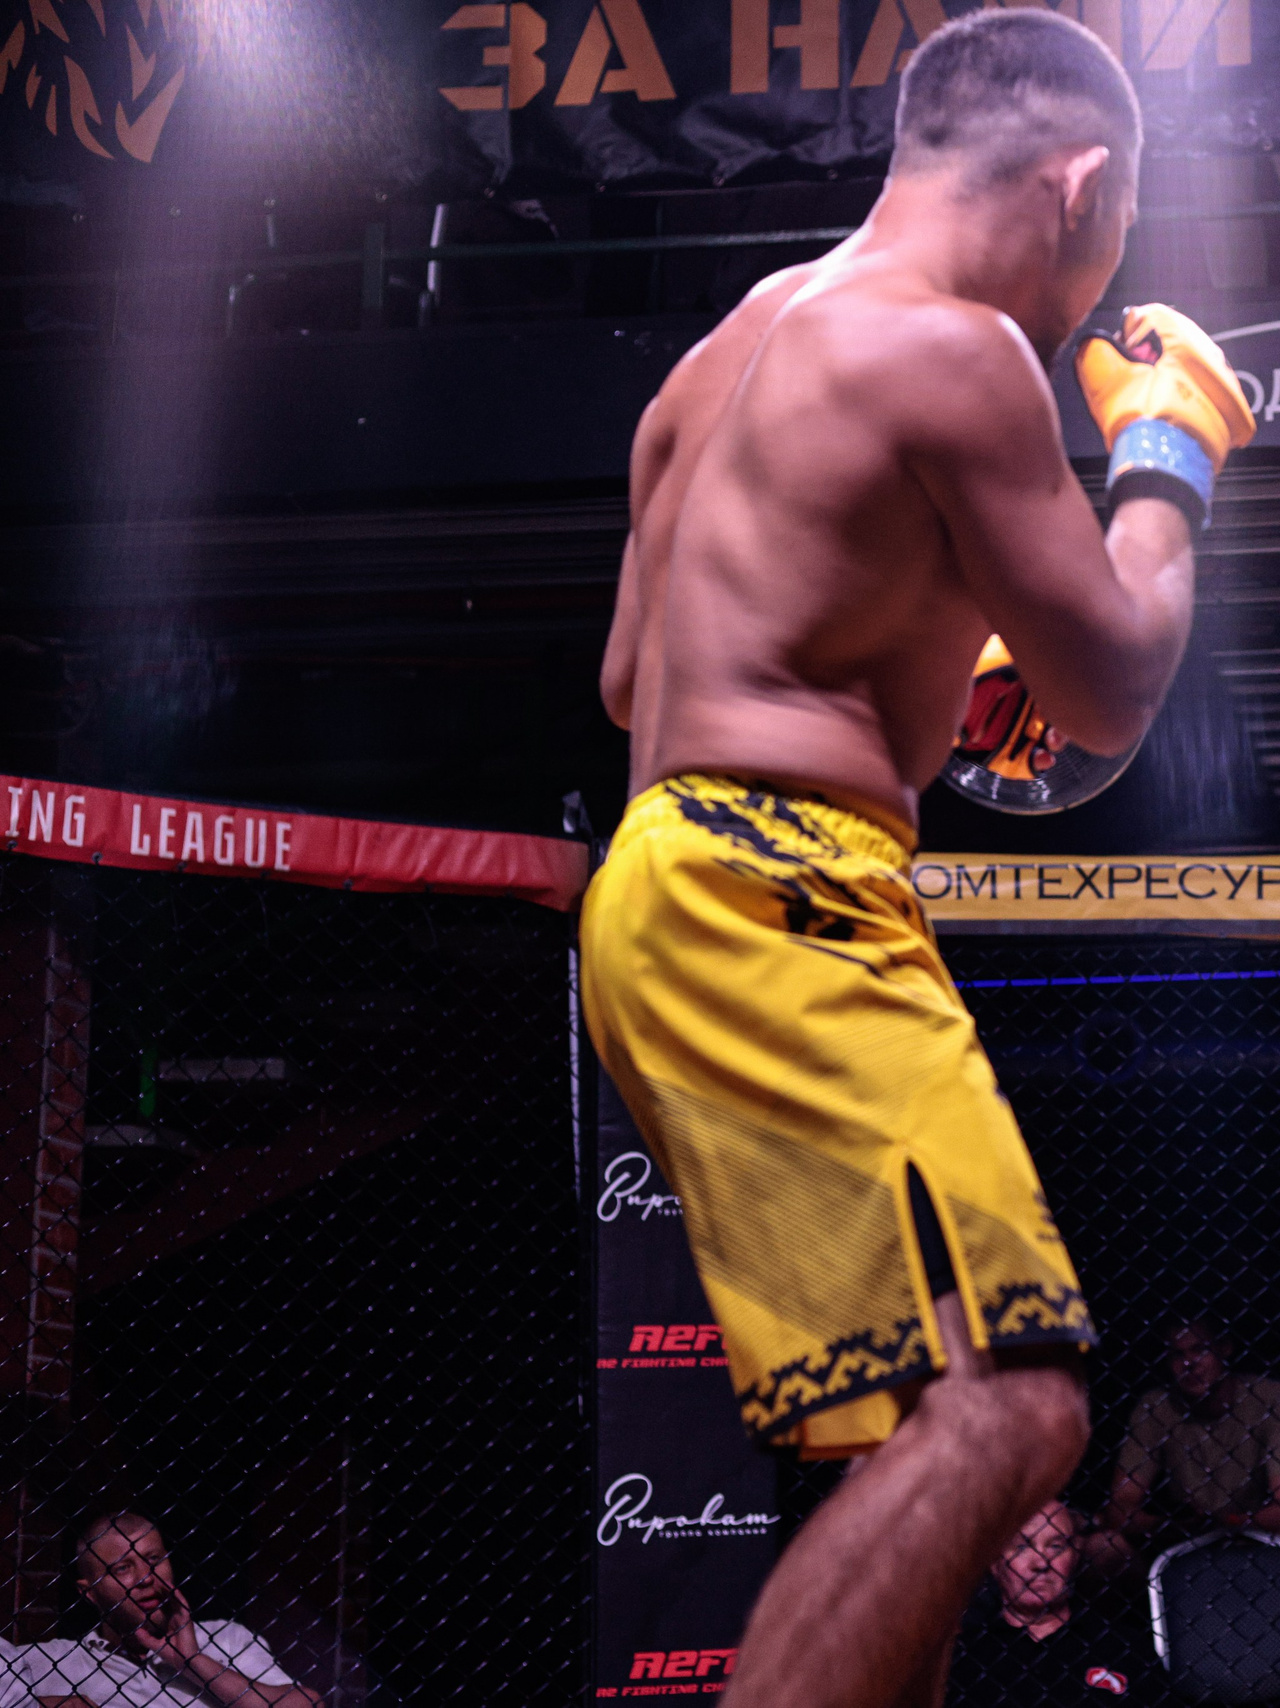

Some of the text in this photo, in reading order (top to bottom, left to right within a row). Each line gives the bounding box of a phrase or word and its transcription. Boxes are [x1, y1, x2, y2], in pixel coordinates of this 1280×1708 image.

[439, 0, 1251, 111] ЗА НАИ
[130, 804, 292, 871] LEAGUE
